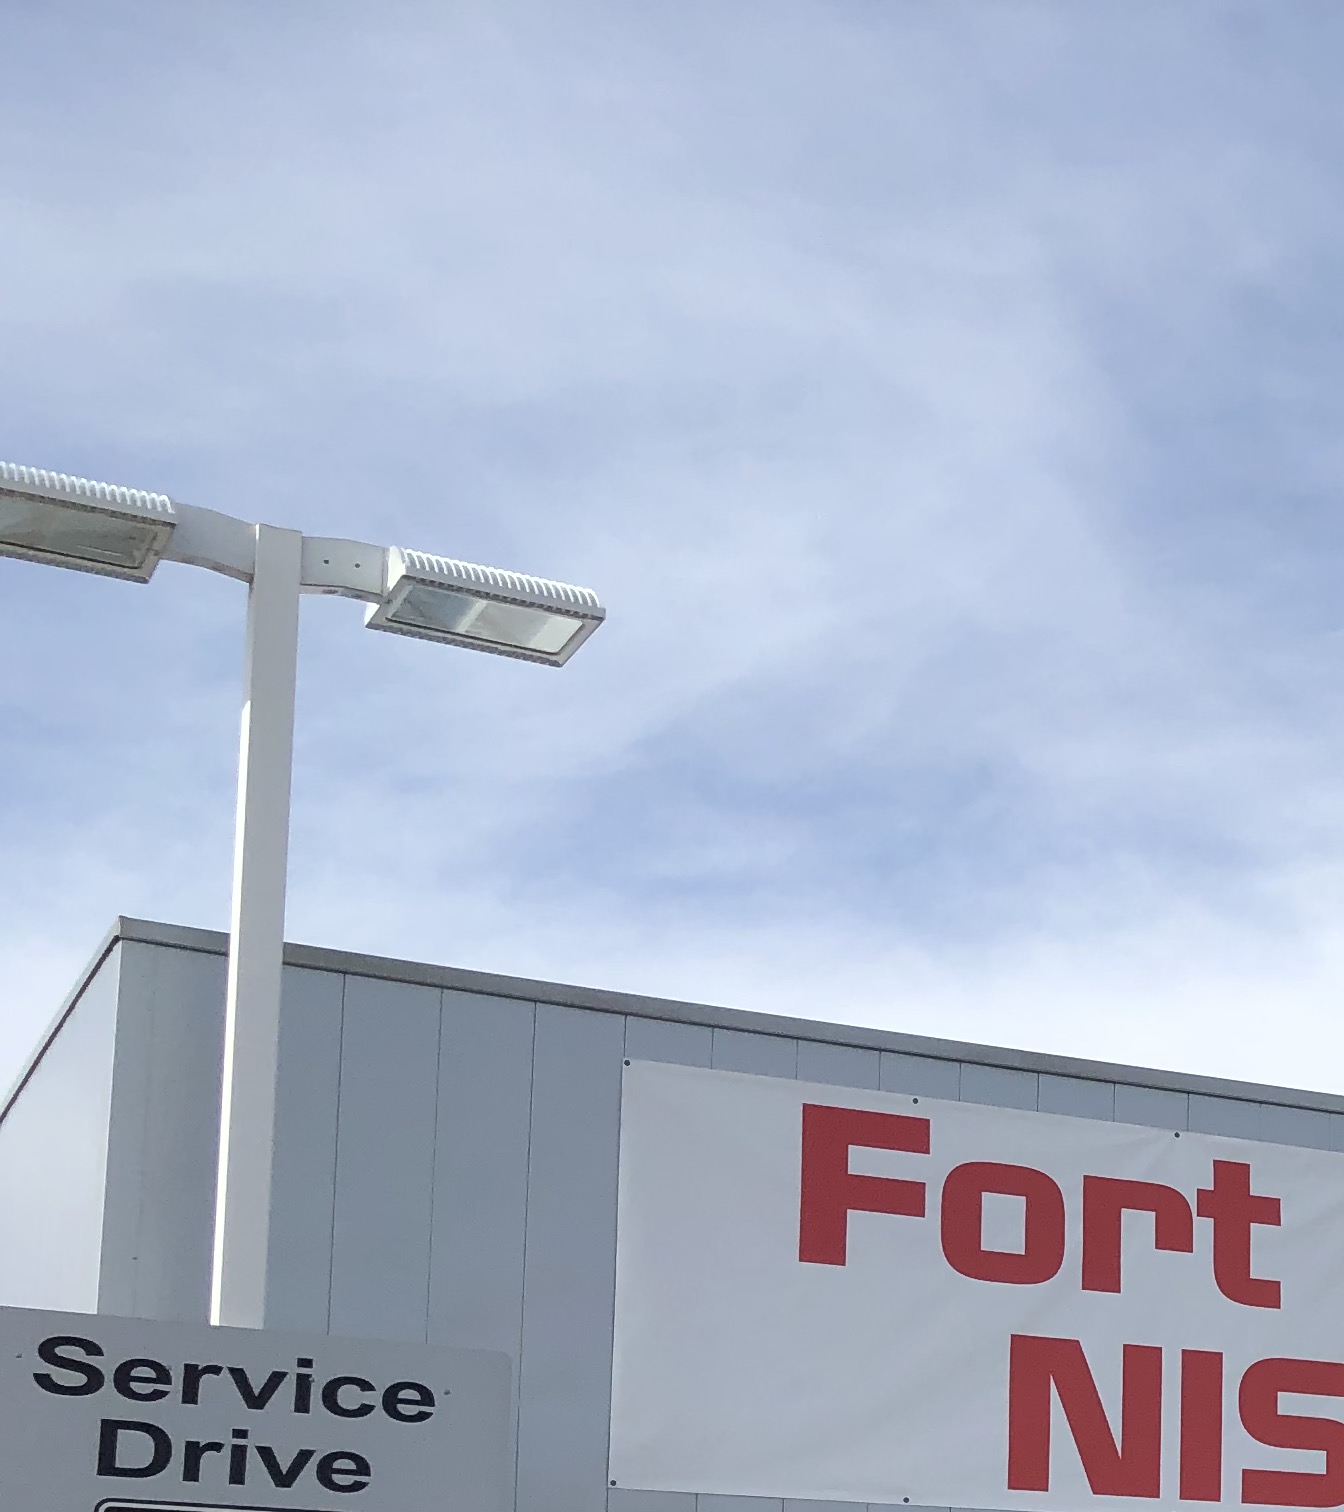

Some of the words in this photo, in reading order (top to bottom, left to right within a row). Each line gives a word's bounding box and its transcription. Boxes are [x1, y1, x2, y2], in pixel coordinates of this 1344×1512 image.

[799, 1102, 1282, 1310] Fort
[33, 1335, 436, 1423] Service
[96, 1418, 372, 1494] Drive
